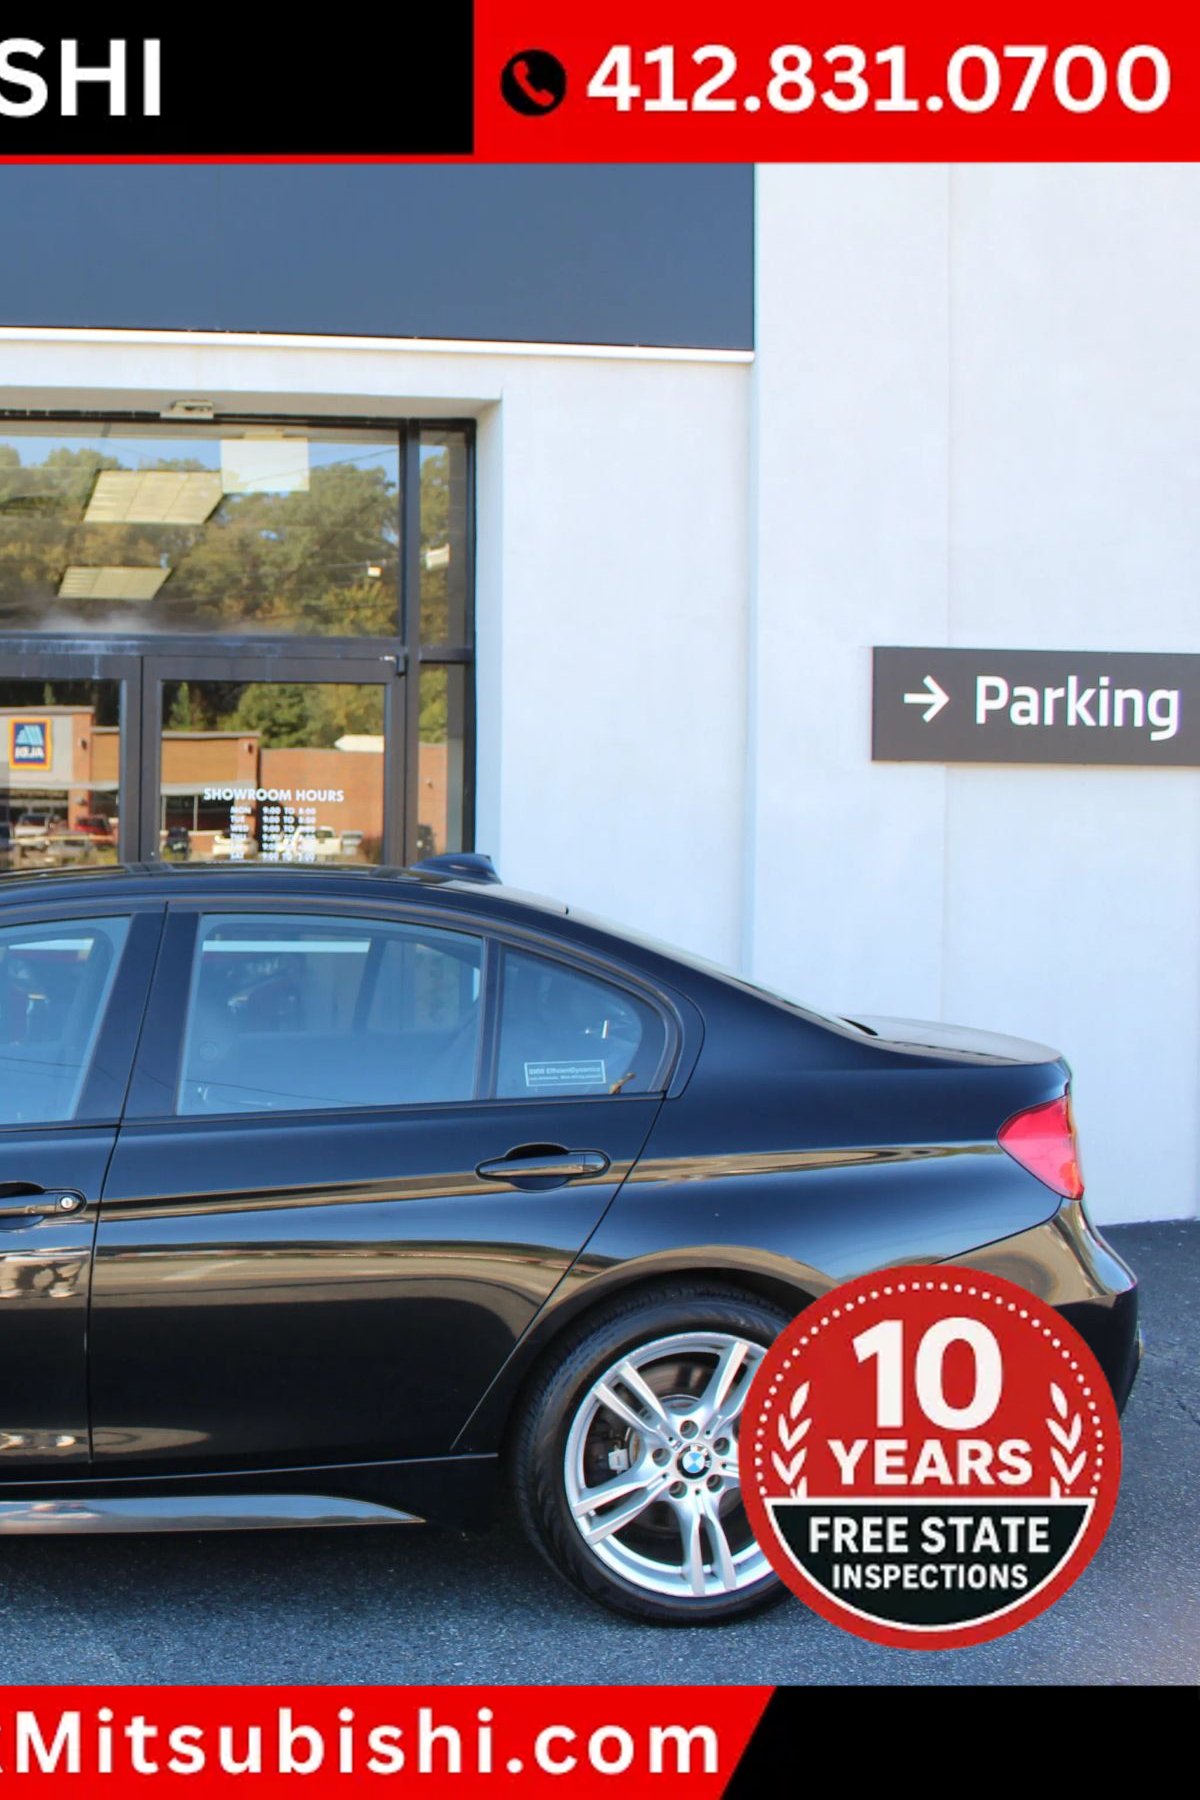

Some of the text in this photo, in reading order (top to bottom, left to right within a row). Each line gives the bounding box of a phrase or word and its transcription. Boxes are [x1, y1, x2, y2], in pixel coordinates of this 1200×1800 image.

[976, 675, 1179, 741] Parking
[203, 787, 345, 803] SHOWROOM HOURS
